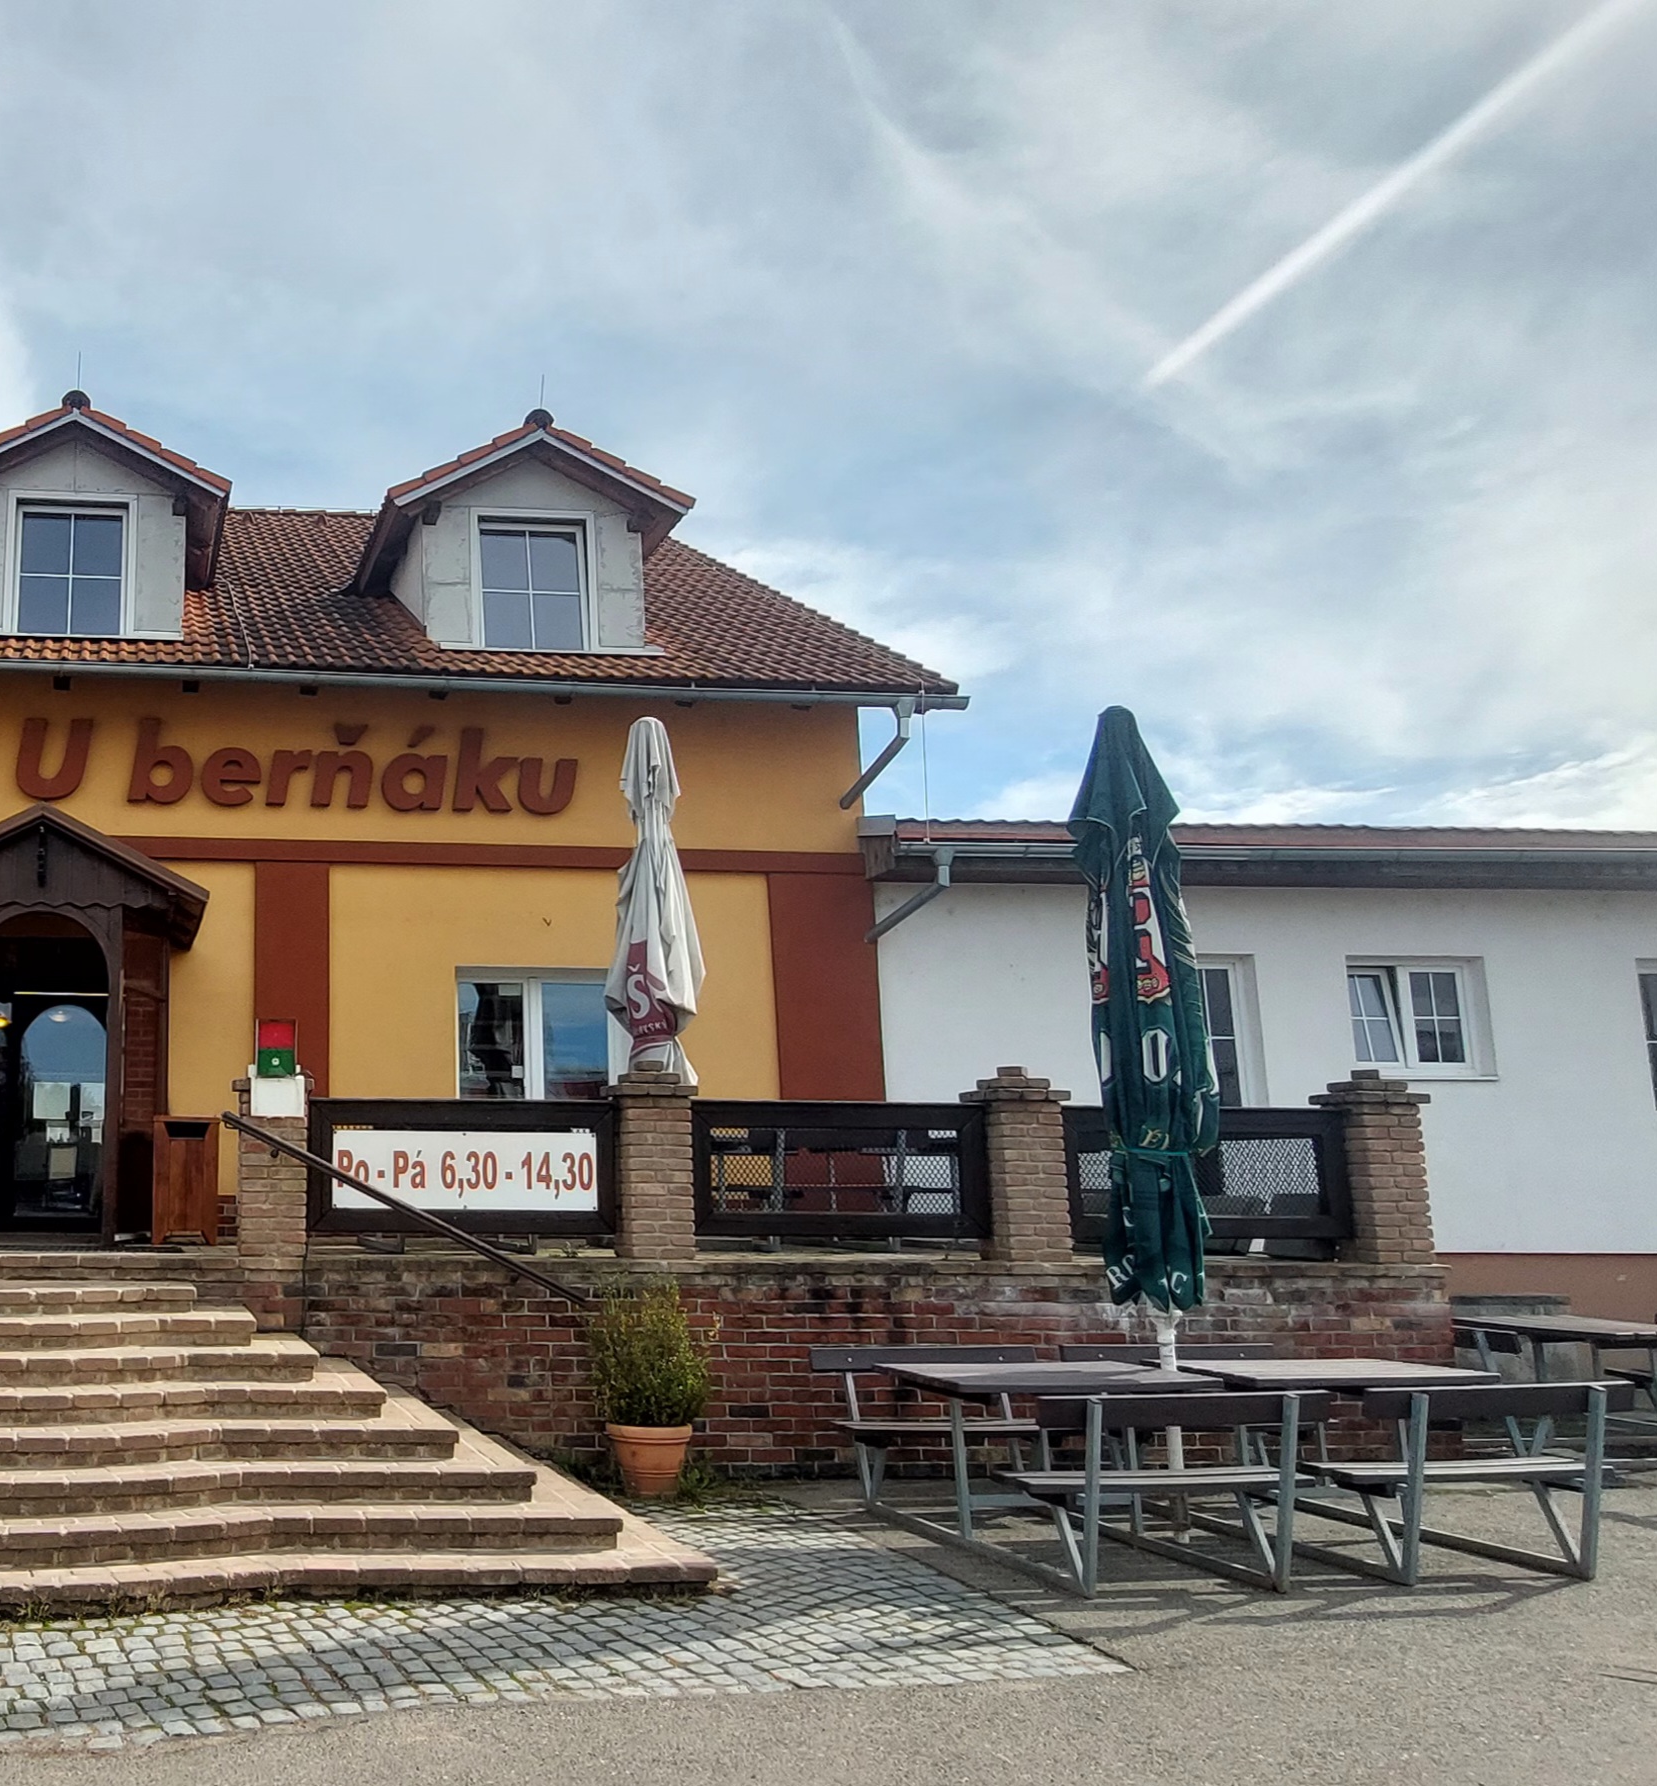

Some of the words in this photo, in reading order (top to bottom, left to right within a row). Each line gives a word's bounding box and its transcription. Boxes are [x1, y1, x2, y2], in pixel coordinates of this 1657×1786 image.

[16, 717, 94, 801] U
[127, 717, 579, 815] berňáku
[337, 1149, 370, 1188] Po
[393, 1150, 426, 1189] Pá
[441, 1150, 498, 1199] 6,30
[521, 1151, 593, 1200] 14,30
